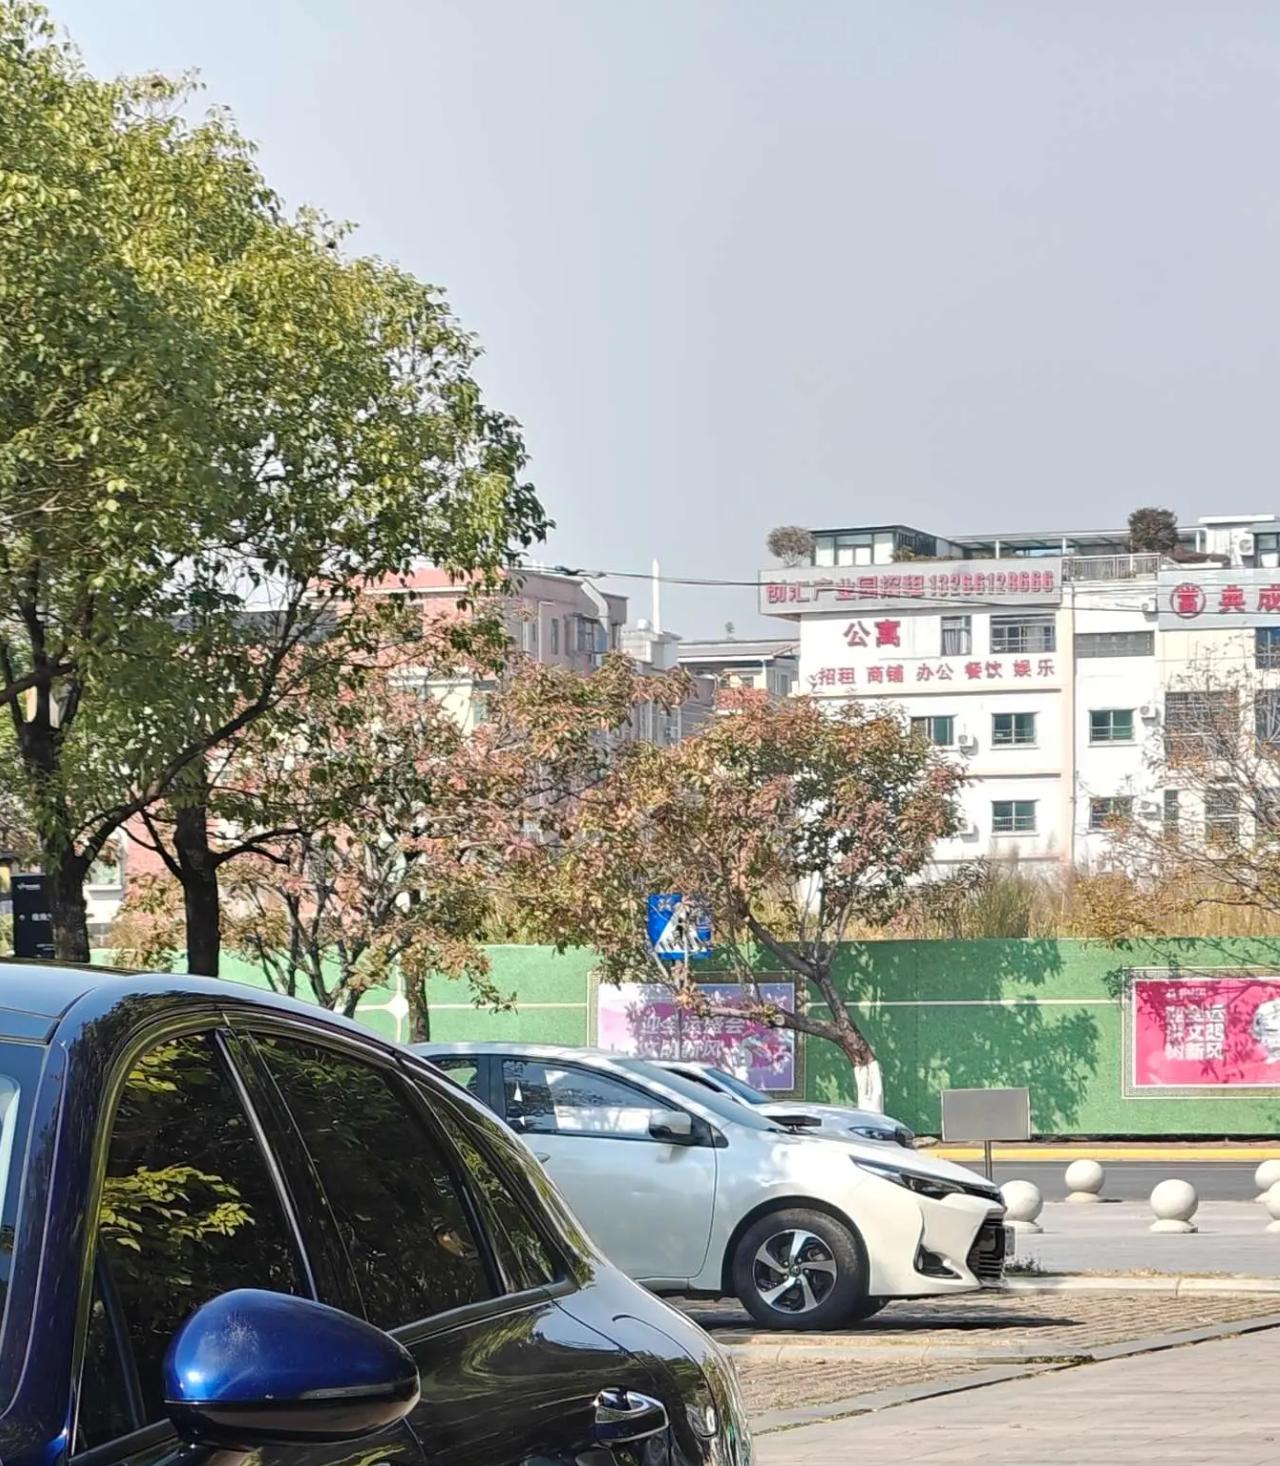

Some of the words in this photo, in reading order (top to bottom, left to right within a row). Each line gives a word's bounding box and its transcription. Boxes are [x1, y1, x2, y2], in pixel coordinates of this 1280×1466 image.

[843, 619, 902, 648] 公寓
[818, 666, 856, 686] 招租
[866, 665, 905, 683] 商铺
[916, 663, 955, 682] 办公
[964, 661, 1003, 680] 餐饮
[1013, 659, 1056, 678] 娱乐
